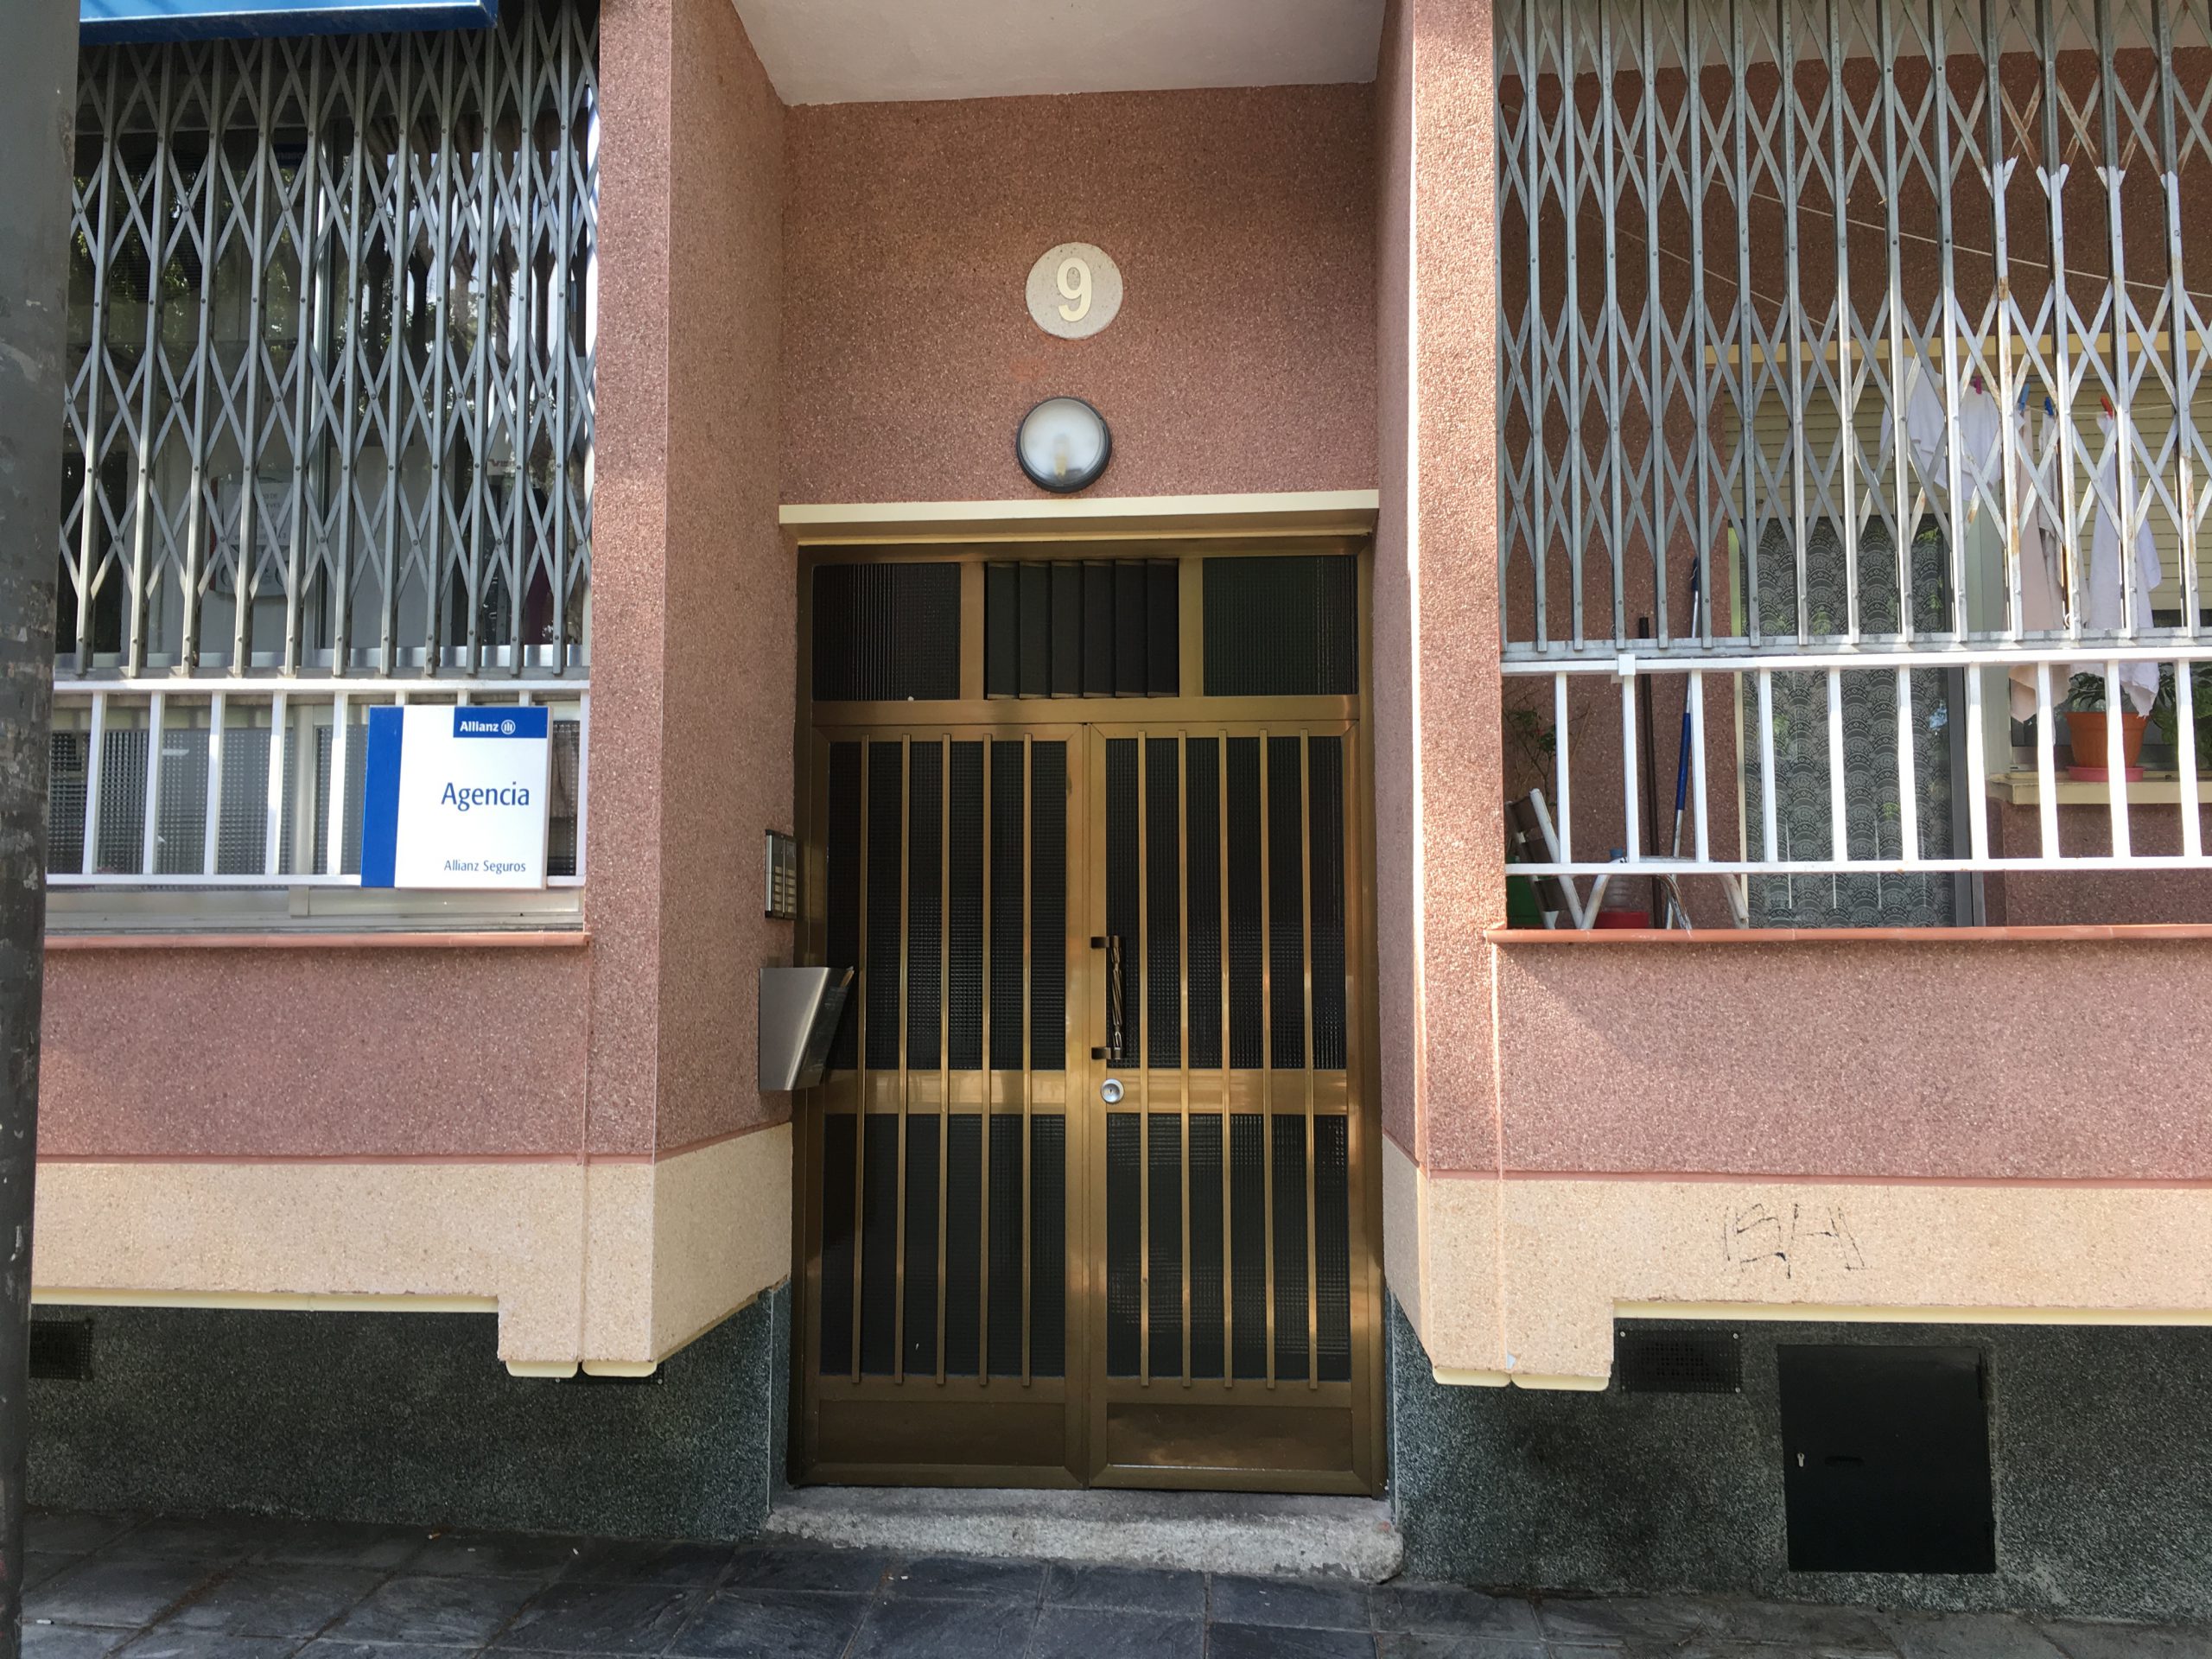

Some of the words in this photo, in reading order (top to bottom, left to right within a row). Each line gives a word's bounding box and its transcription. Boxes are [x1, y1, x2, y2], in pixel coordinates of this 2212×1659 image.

[1056, 257, 1092, 322] 9
[460, 721, 499, 733] Allianz
[441, 781, 530, 811] Agencia
[443, 860, 480, 871] Allianz
[482, 860, 526, 874] Seguros
